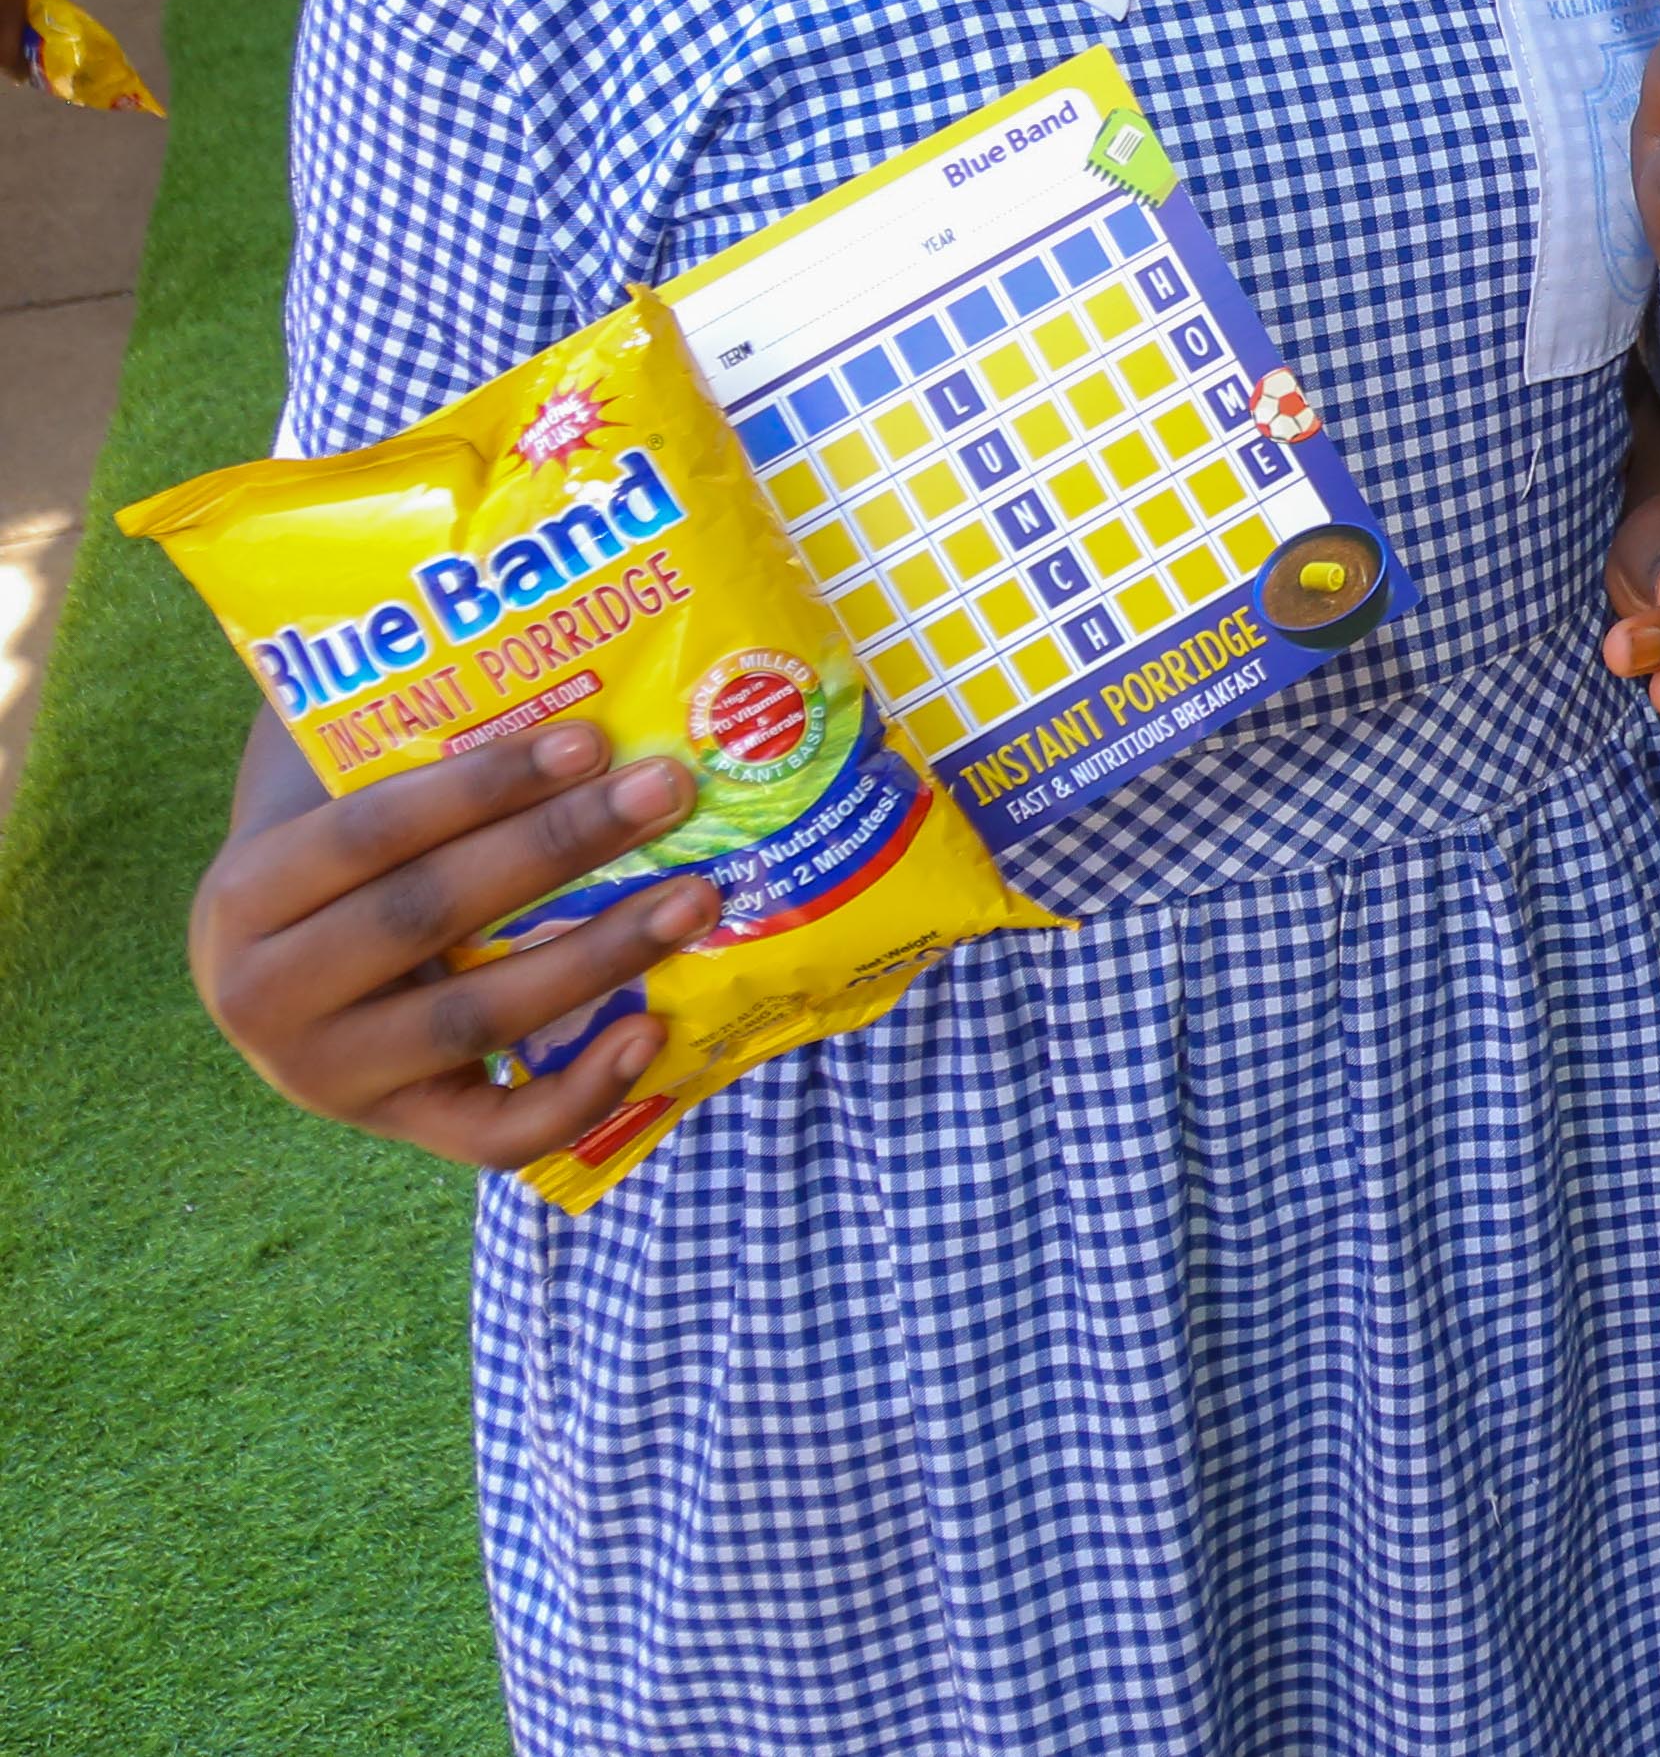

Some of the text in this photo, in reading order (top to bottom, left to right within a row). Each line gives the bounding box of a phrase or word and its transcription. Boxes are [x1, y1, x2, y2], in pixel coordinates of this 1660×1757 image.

[942, 99, 1080, 189] Blue Band
[921, 227, 958, 256] YEAR
[717, 339, 754, 371] TERM
[251, 452, 684, 720] Blue Band
[316, 550, 693, 773] INSTANT PORRIDGE
[690, 668, 726, 741] WHOLE
[739, 653, 813, 684] MILLED
[722, 679, 766, 710] High in
[451, 675, 596, 755] COMPOSITE FLOUR
[732, 684, 796, 723] Vitamins
[742, 709, 806, 752] Minerals
[756, 715, 771, 727] &
[958, 605, 1269, 808] INSTANT PORRIDGE
[1005, 657, 1269, 825] FAST & NUTRITIOUS BREAKFAST
[716, 705, 827, 784] PLANT BASED
[720, 785, 902, 919] ady in 2 Minutes!
[758, 773, 878, 870] Nutritious
[854, 955, 882, 975] Net
[882, 930, 942, 966] Weight
